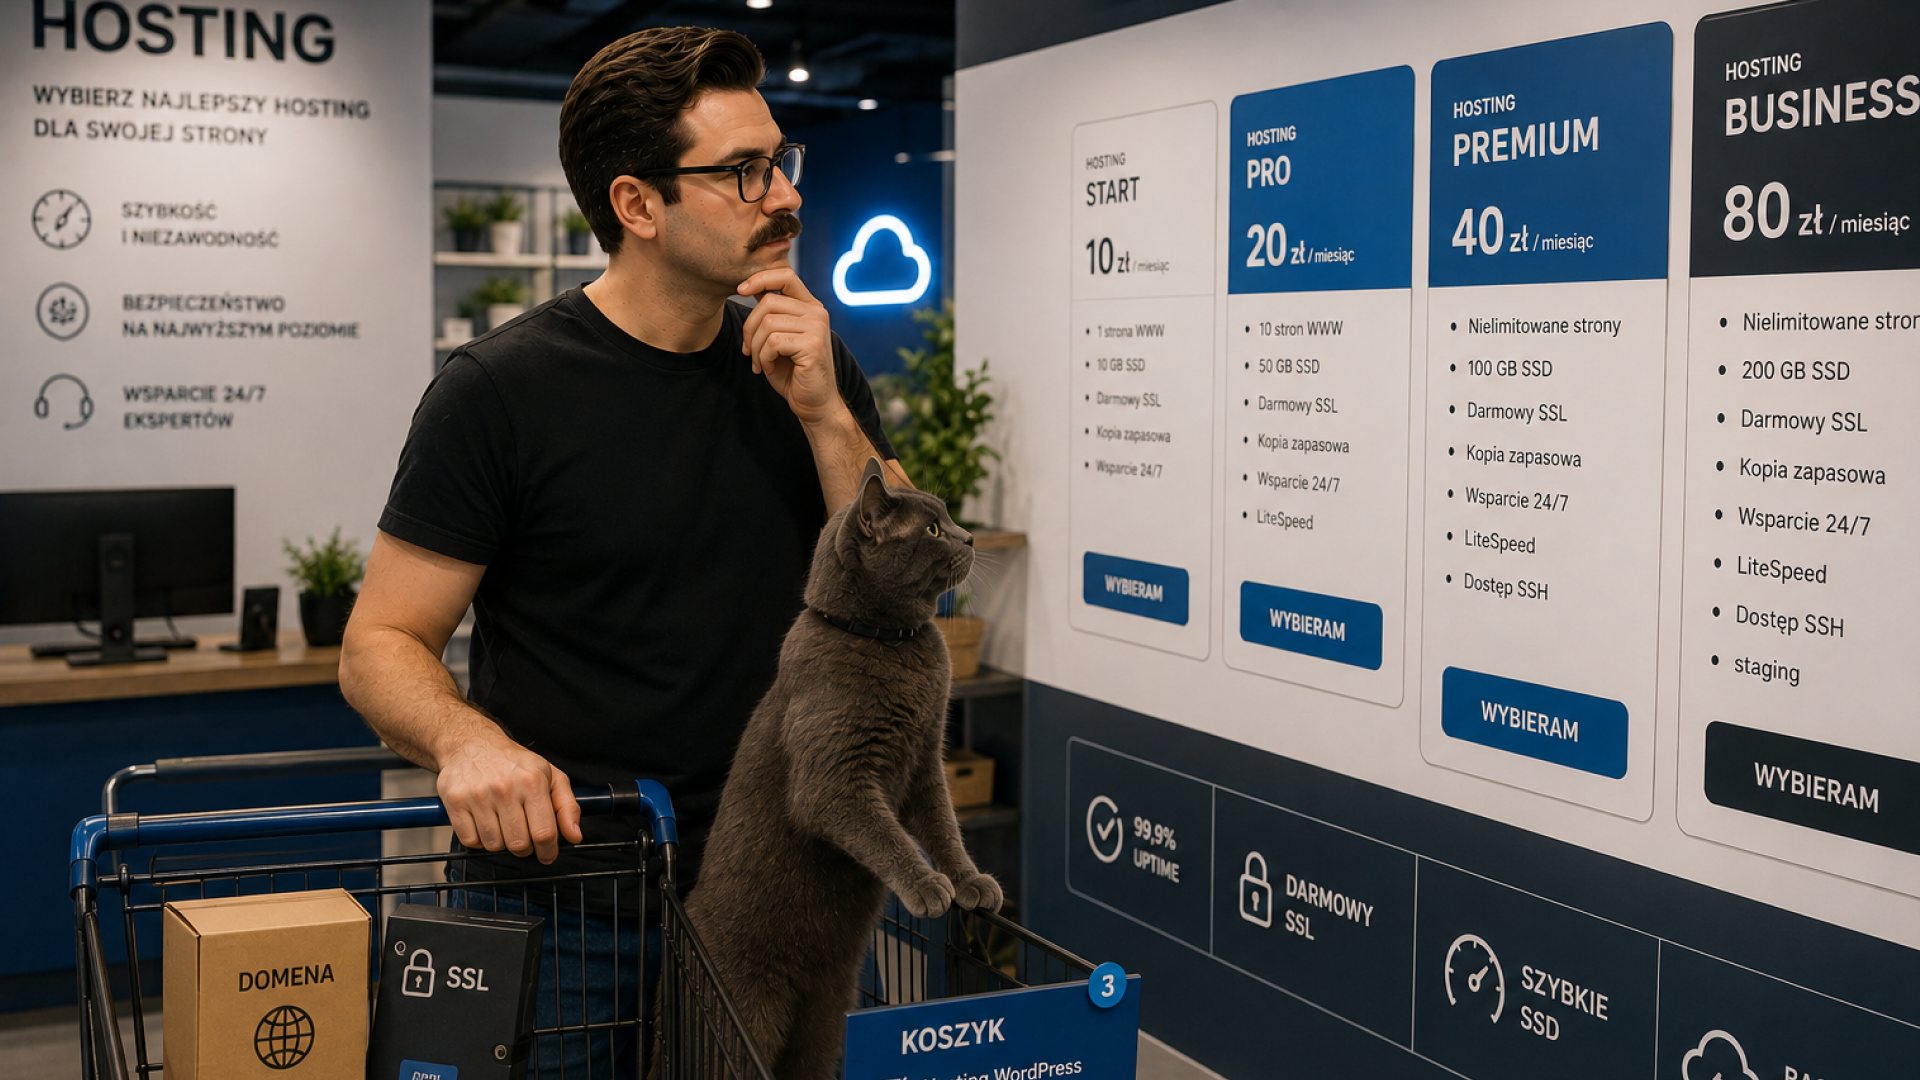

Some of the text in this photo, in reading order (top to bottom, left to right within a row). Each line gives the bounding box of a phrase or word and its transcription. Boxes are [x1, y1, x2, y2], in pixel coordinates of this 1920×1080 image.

[33, 0, 335, 63] HOSTING
[1725, 52, 1802, 82] HOSTING
[31, 82, 372, 120] WYBIERZ NAJLEPSZY HOSTING
[1453, 93, 1516, 119] HOSTING
[1725, 75, 1920, 137] BUSINESS
[33, 117, 268, 145] DLA SWOJEJ STRONY
[1247, 125, 1297, 147] HOSTING
[1453, 116, 1599, 167] PREMIUM
[1085, 151, 1126, 170] HOSTING
[1247, 155, 1291, 189] PRO
[1086, 175, 1141, 207] START
[121, 200, 217, 220] SZYBKOŚĆ
[1723, 181, 1790, 242] 80
[1798, 203, 1824, 236] zł
[1841, 211, 1911, 236] miesiąc
[132, 229, 279, 248] NIEZAWODNOŚĆ
[1451, 205, 1504, 256] 40
[1509, 224, 1529, 253] zł
[1541, 232, 1594, 254] miesiąc
[1086, 236, 1114, 275] 10
[1117, 250, 1131, 274] zł
[1246, 222, 1287, 268] 20
[1290, 239, 1306, 265] zł
[1314, 246, 1355, 266] miesiąc
[122, 292, 286, 312] BEZPIECZEŃSTWO
[122, 319, 359, 339] NA NAJWYŻSZYM POZIOMIE
[1104, 326, 1134, 338] strona
[1135, 323, 1165, 338] WWW
[1259, 320, 1344, 337] 10 stron WWW
[1468, 317, 1622, 338] Nielimitowane strony
[1743, 312, 1869, 331] Nielimitowane
[1097, 357, 1146, 372] 10 GB SSD
[1258, 358, 1321, 375] 50 GB SSD
[1468, 359, 1553, 377] 100 GB SSD
[1742, 360, 1850, 381] 200 GB SSD
[123, 385, 266, 404] WSPARCIE 24/7
[1096, 390, 1162, 410] Darmowy SSL
[1258, 395, 1338, 417] Darmowy SSL
[123, 410, 234, 430] EKSPERTÓW
[1467, 401, 1568, 425] Darmowy SSL
[1741, 408, 1868, 436] Darmowy SSL
[1096, 425, 1171, 445] Kopia zapasowa
[1257, 433, 1350, 454] Kopia zapasowa
[1095, 460, 1163, 478] Wsparcie 24/7
[1467, 443, 1582, 469] Kopia zapasowa
[1257, 471, 1341, 493] Wsparcie 24/7
[1740, 457, 1886, 486] Kopia zapasowa
[1465, 486, 1569, 512] Wsparcie 24/7
[1256, 509, 1314, 531] LiteSpeed
[1738, 506, 1871, 537] Wsparcie 24/7
[1465, 529, 1536, 555] LiteSpeed
[1737, 555, 1827, 585] LiteSpeed
[1104, 574, 1164, 603] WYBIERAM
[1464, 572, 1548, 601] Dostęp SSH
[1269, 608, 1346, 642] WYBIERAM
[1736, 604, 1844, 638] Dostęp SSH
[1734, 656, 1800, 688] staging
[1481, 699, 1579, 743] WYBIERAM
[1754, 761, 1879, 814] WYBIERAM
[1133, 816, 1177, 850] 99,9%
[1133, 848, 1180, 884] UPTIME
[1286, 873, 1374, 927] DARMOWY
[1285, 909, 1315, 941] SSL
[238, 963, 335, 993] DOMENA
[446, 965, 489, 992] SSL
[1101, 974, 1115, 998] 3
[1521, 964, 1609, 1021] SZYBKIE
[901, 1017, 1005, 1055] KOSZYK
[1520, 1005, 1560, 1041] SSD
[993, 1060, 1082, 1080] WordPress
